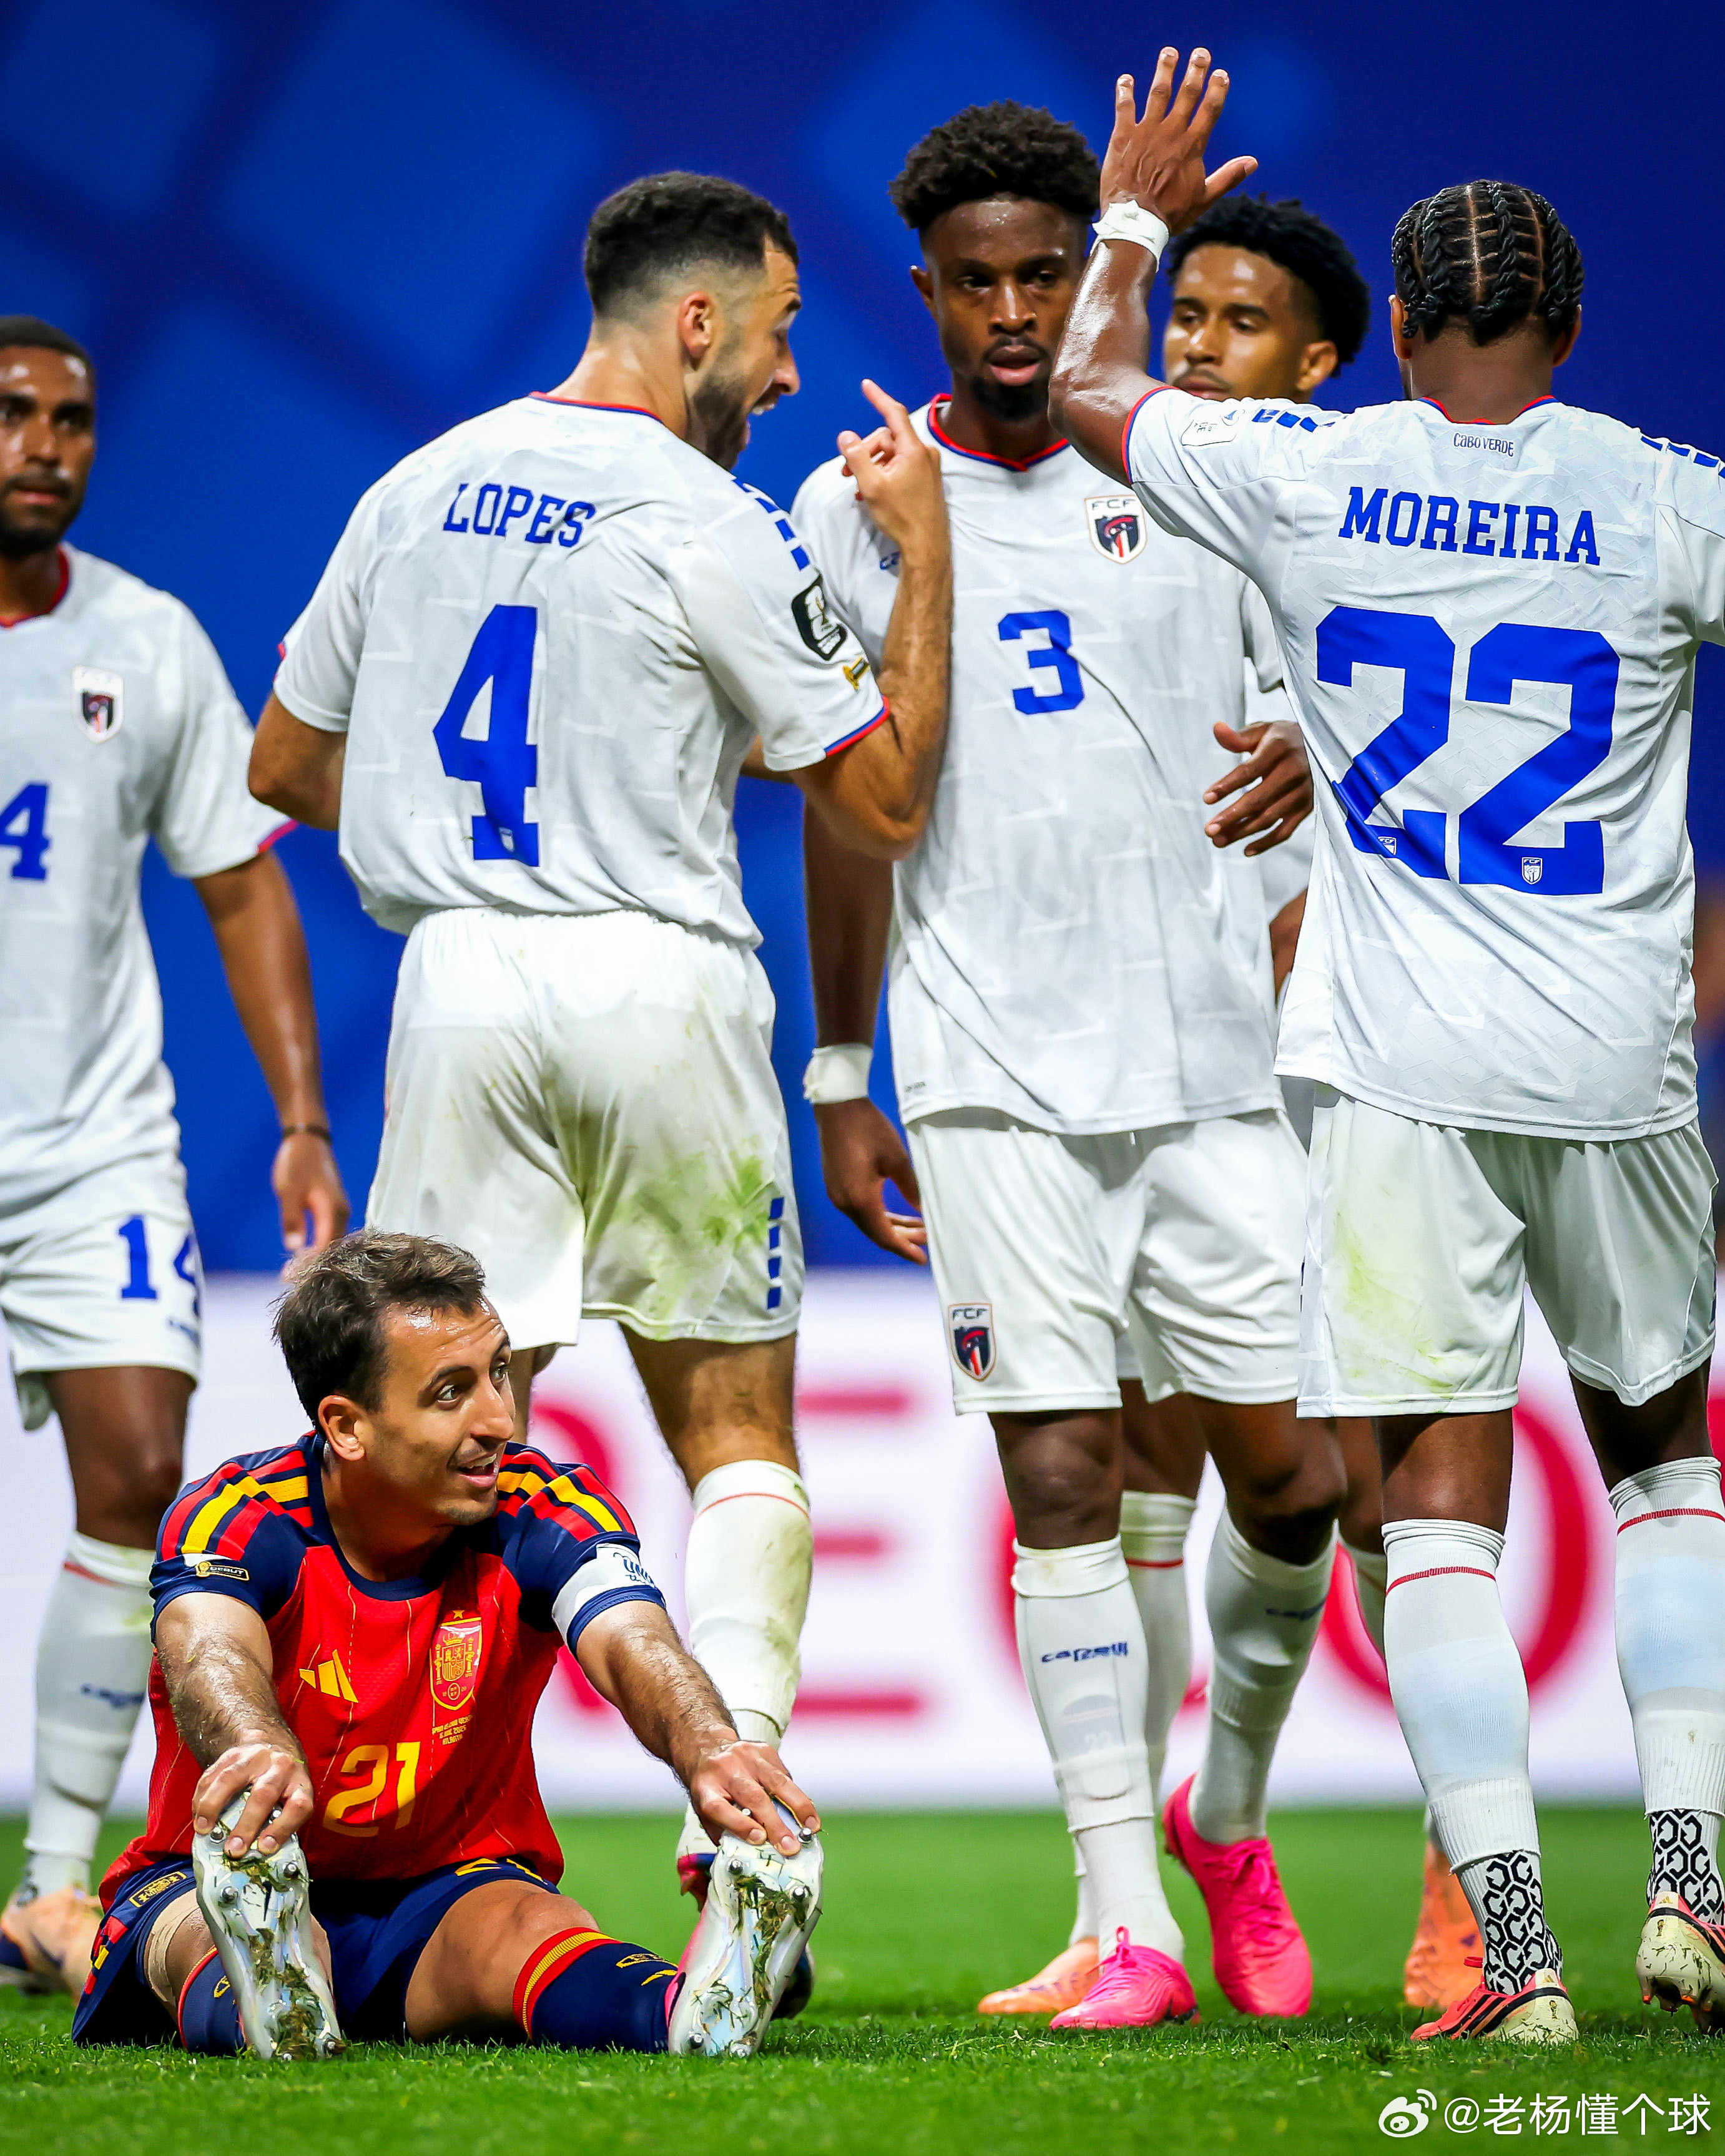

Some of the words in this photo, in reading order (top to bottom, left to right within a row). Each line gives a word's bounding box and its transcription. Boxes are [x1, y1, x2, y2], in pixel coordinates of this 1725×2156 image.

[1483, 437, 1514, 457] VERDE
[443, 483, 596, 548] LOPES
[1091, 498, 1136, 511] FCF
[1338, 486, 1601, 566] MOREIRA
[997, 609, 1086, 715] 3
[433, 603, 541, 868] 4
[1315, 605, 1621, 896] 22
[953, 1307, 988, 1321] FCF
[322, 1741, 421, 1838] 21
